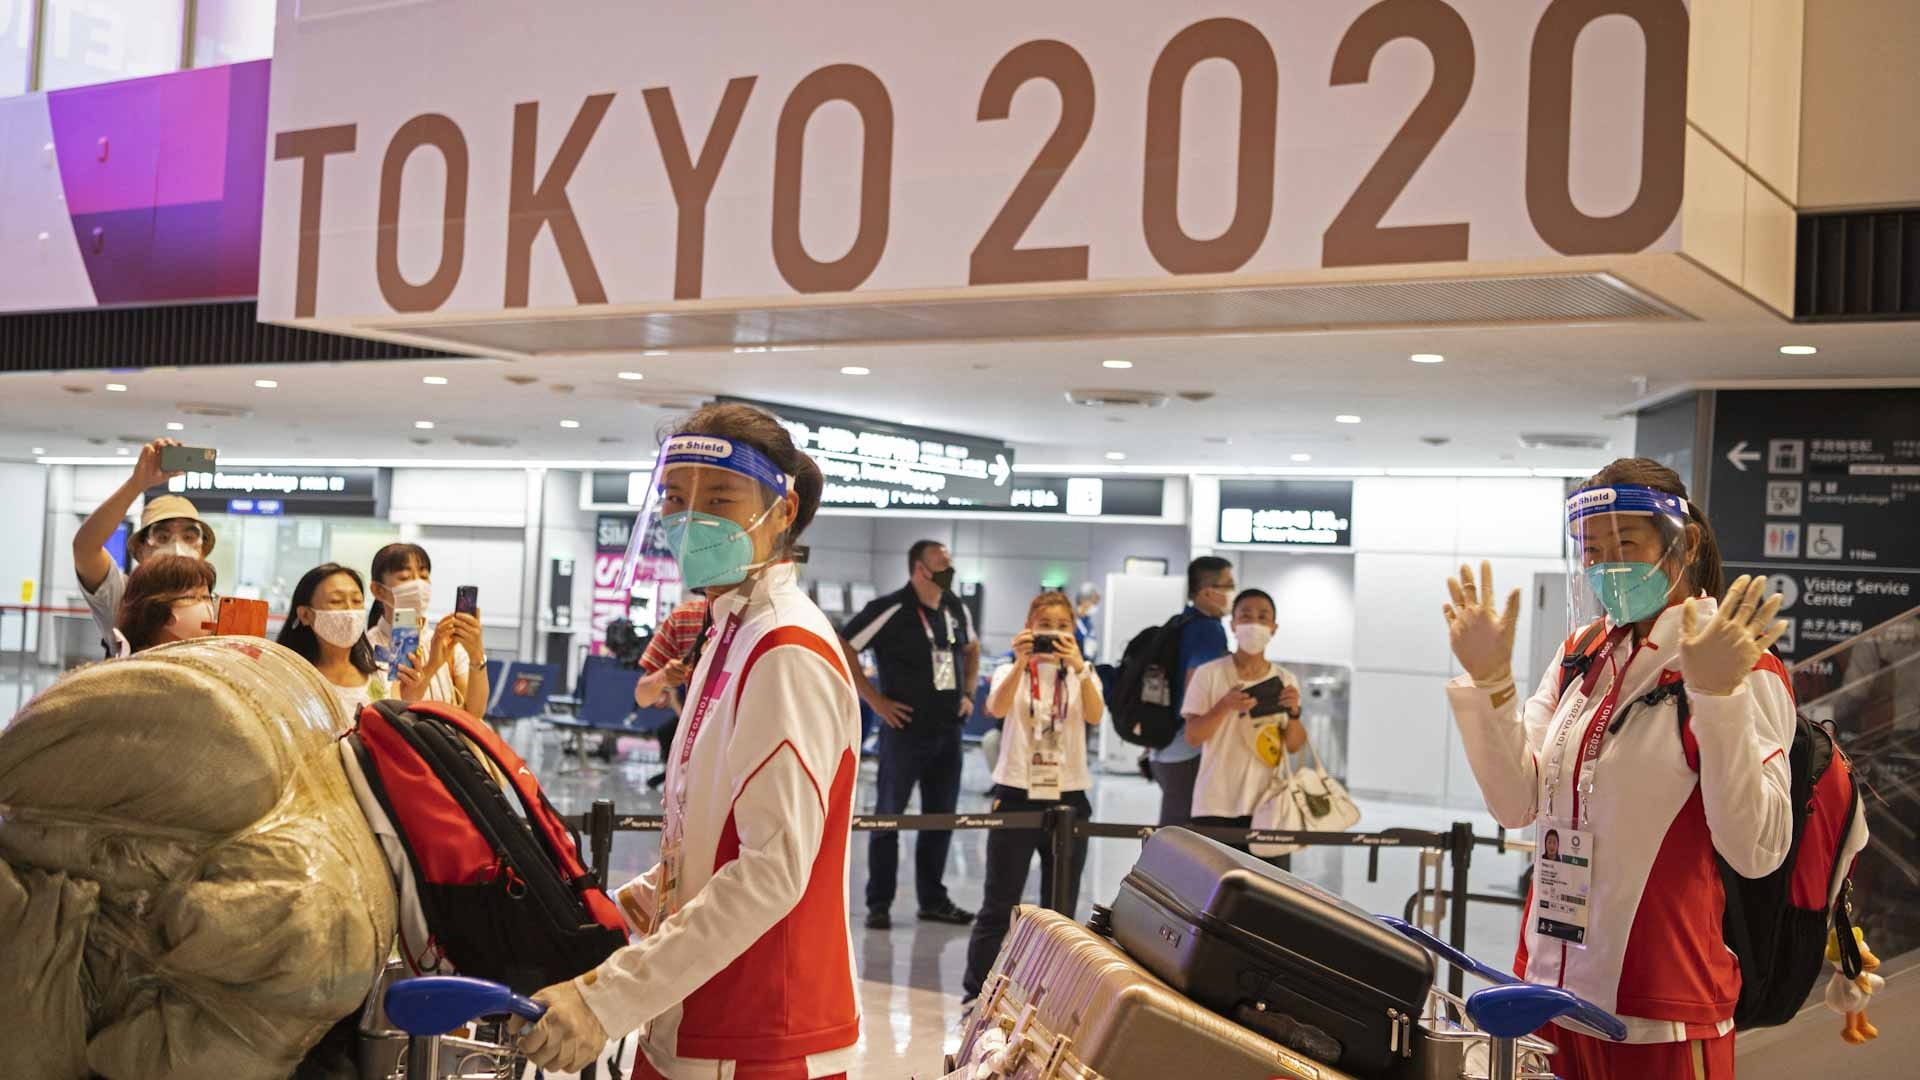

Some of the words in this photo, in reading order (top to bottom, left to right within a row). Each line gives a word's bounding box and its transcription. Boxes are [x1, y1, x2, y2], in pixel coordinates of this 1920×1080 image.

[274, 63, 894, 318] TOKYO
[968, 0, 1690, 286] 2020
[686, 441, 724, 453] Shield
[1579, 493, 1610, 505] Shield
[1803, 577, 1853, 593] Visitor
[1855, 578, 1910, 596] Service
[1803, 592, 1854, 607] Center
[692, 695, 709, 730] TOKYO
[1556, 720, 1573, 746] TOKYO
[1568, 698, 1583, 719] 2020
[1595, 703, 1613, 732] TOKYO
[683, 729, 696, 758] 2020
[1588, 733, 1601, 756] 2020
